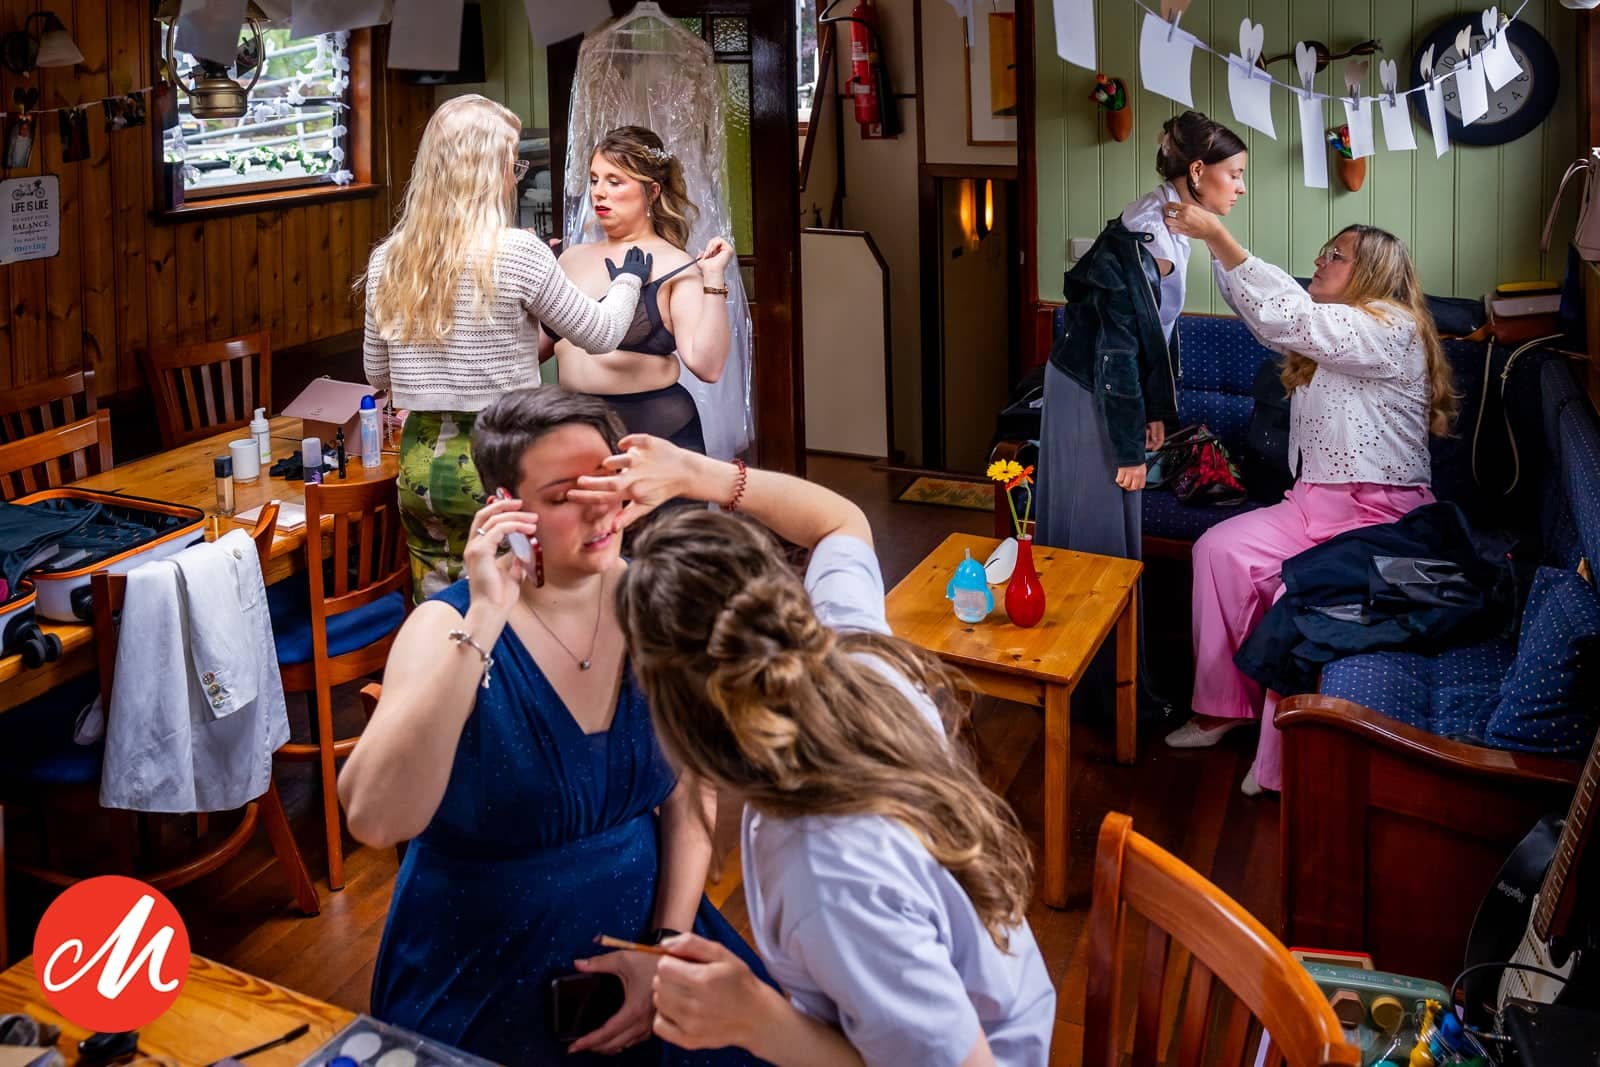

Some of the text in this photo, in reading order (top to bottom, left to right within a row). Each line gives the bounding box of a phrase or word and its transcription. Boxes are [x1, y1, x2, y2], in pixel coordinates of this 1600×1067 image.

[11, 199, 49, 213] LIFE IS LIKE
